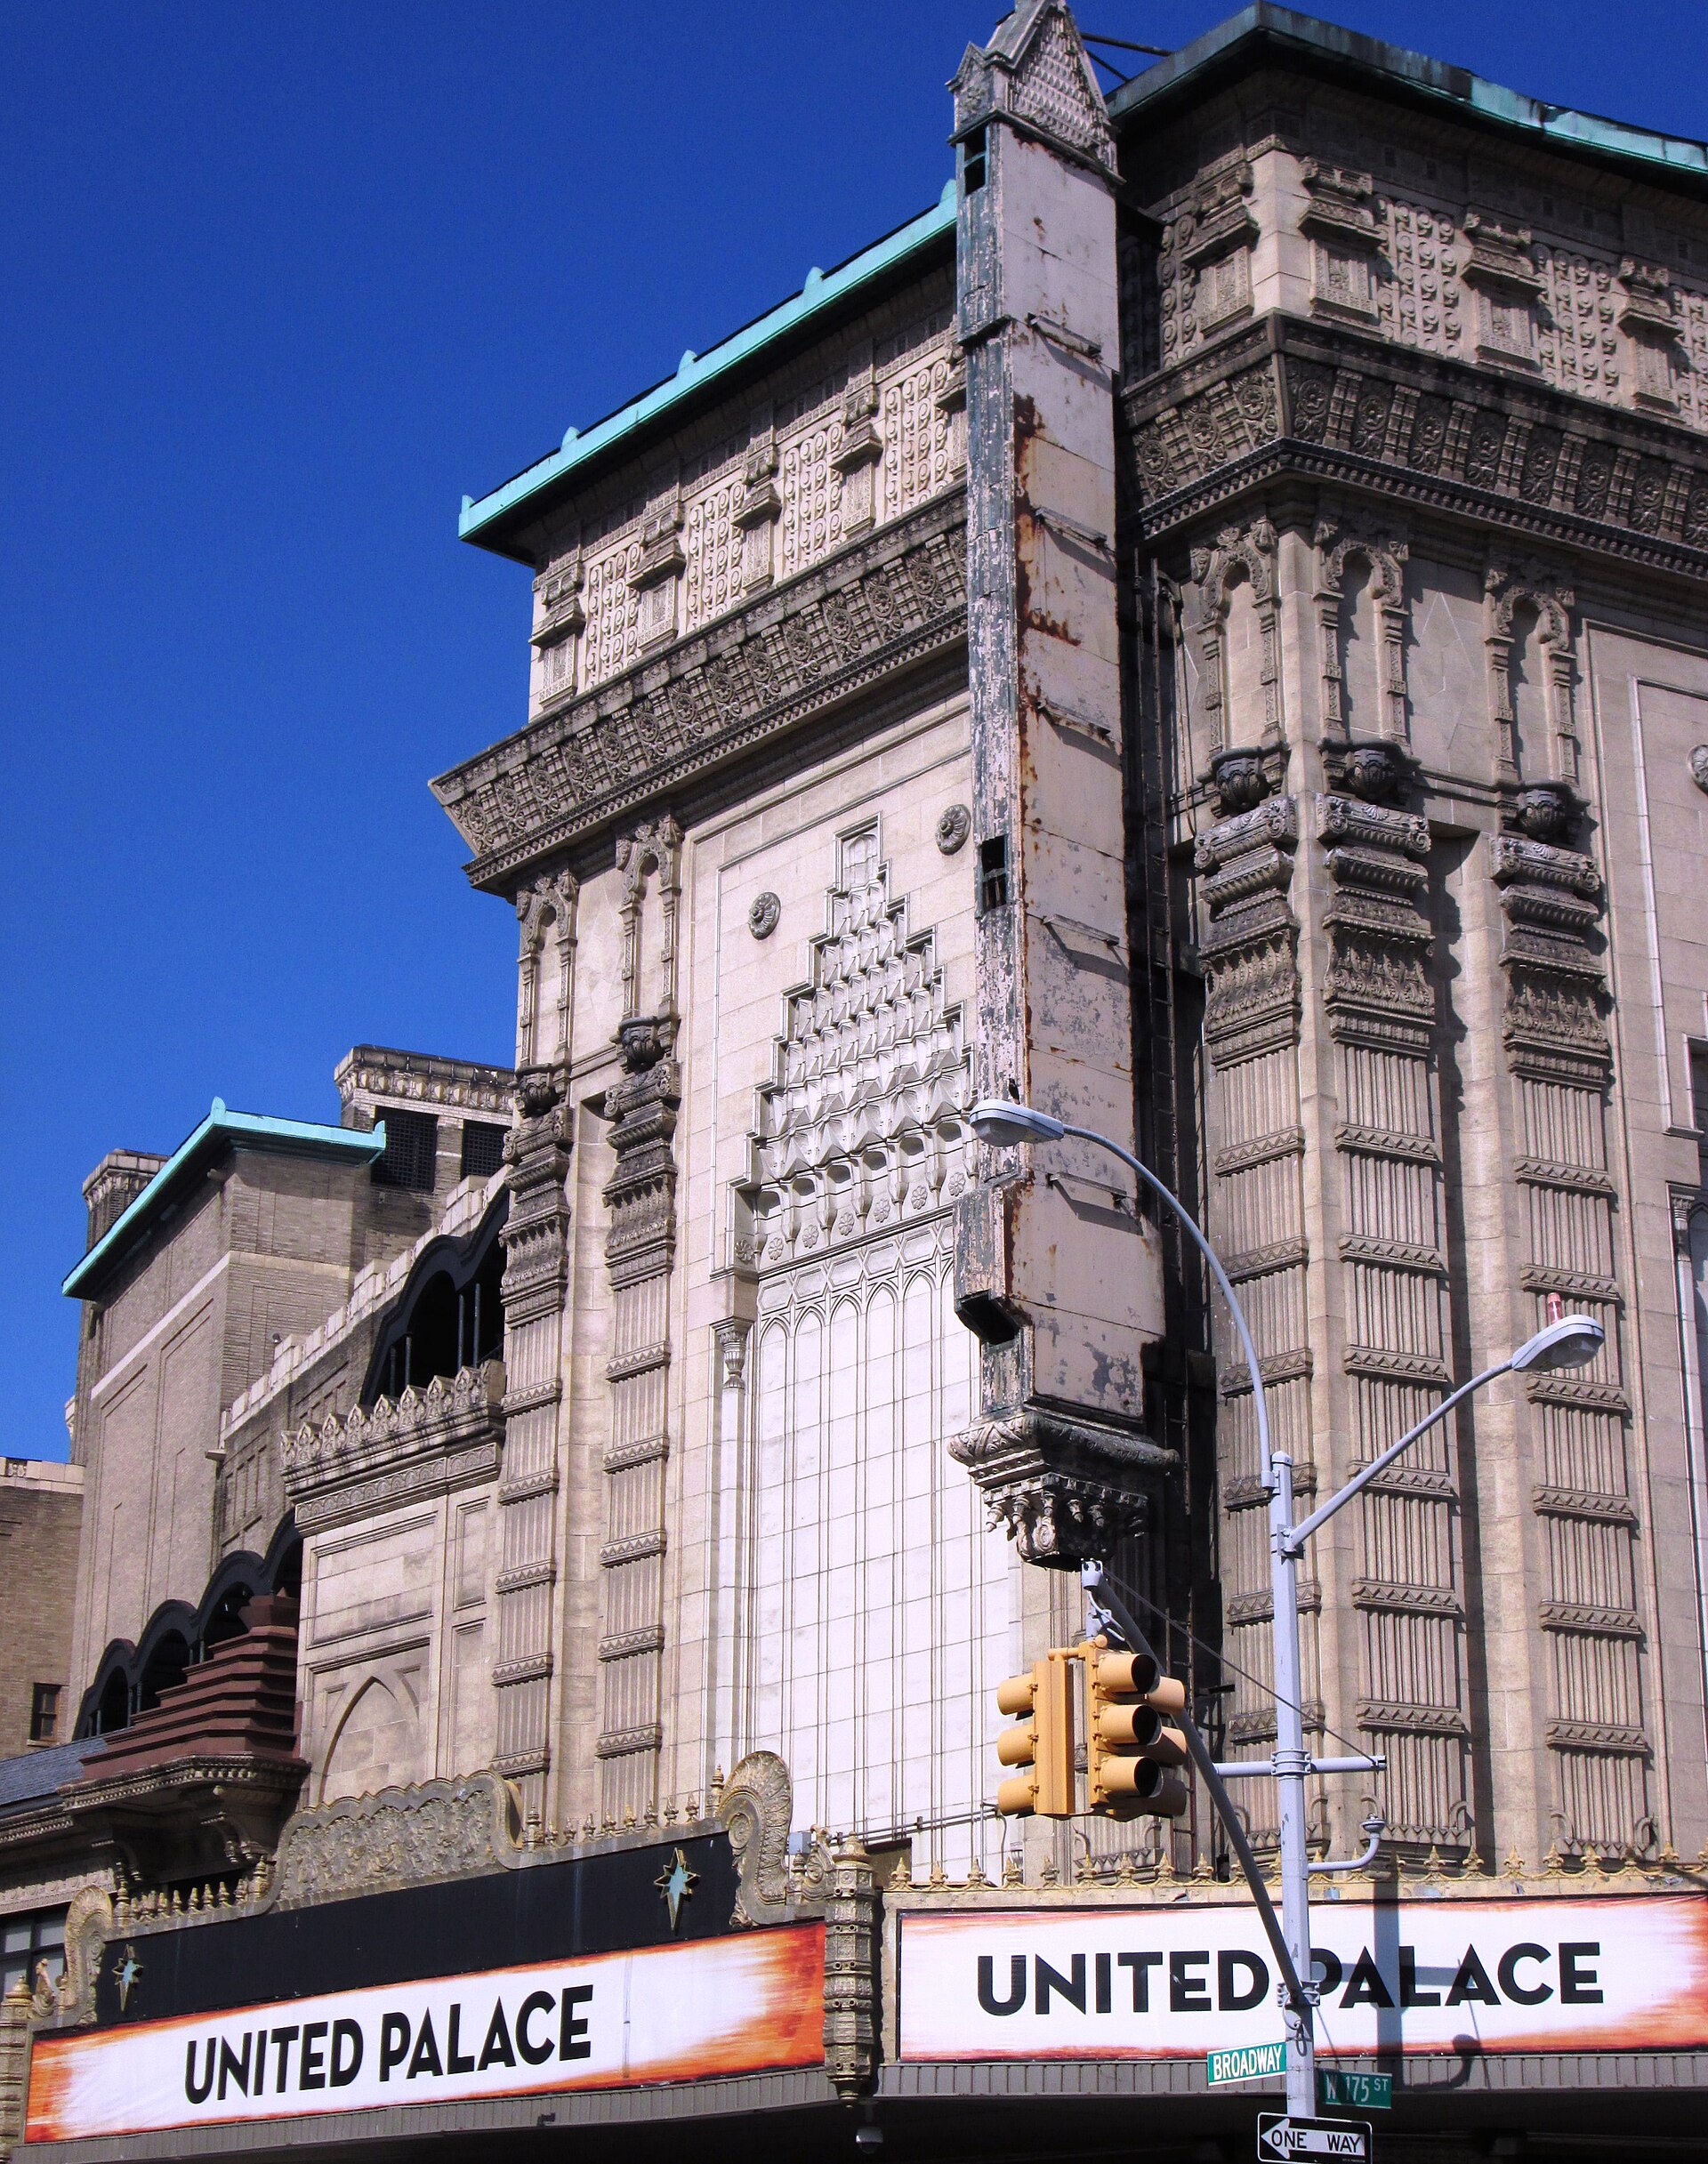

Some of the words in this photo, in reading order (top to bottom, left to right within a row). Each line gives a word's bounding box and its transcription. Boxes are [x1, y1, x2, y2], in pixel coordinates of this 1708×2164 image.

[978, 1950, 1270, 2015] UNITED
[184, 2017, 364, 2104] UNITED
[379, 1984, 593, 2082] PALACE
[1213, 2045, 1282, 2081] BROADWAY
[1325, 2074, 1337, 2100] W
[1345, 2075, 1370, 2102] 175
[1374, 2079, 1389, 2093] ST
[1271, 2129, 1307, 2149] ONE
[1327, 2133, 1360, 2153] WAY
